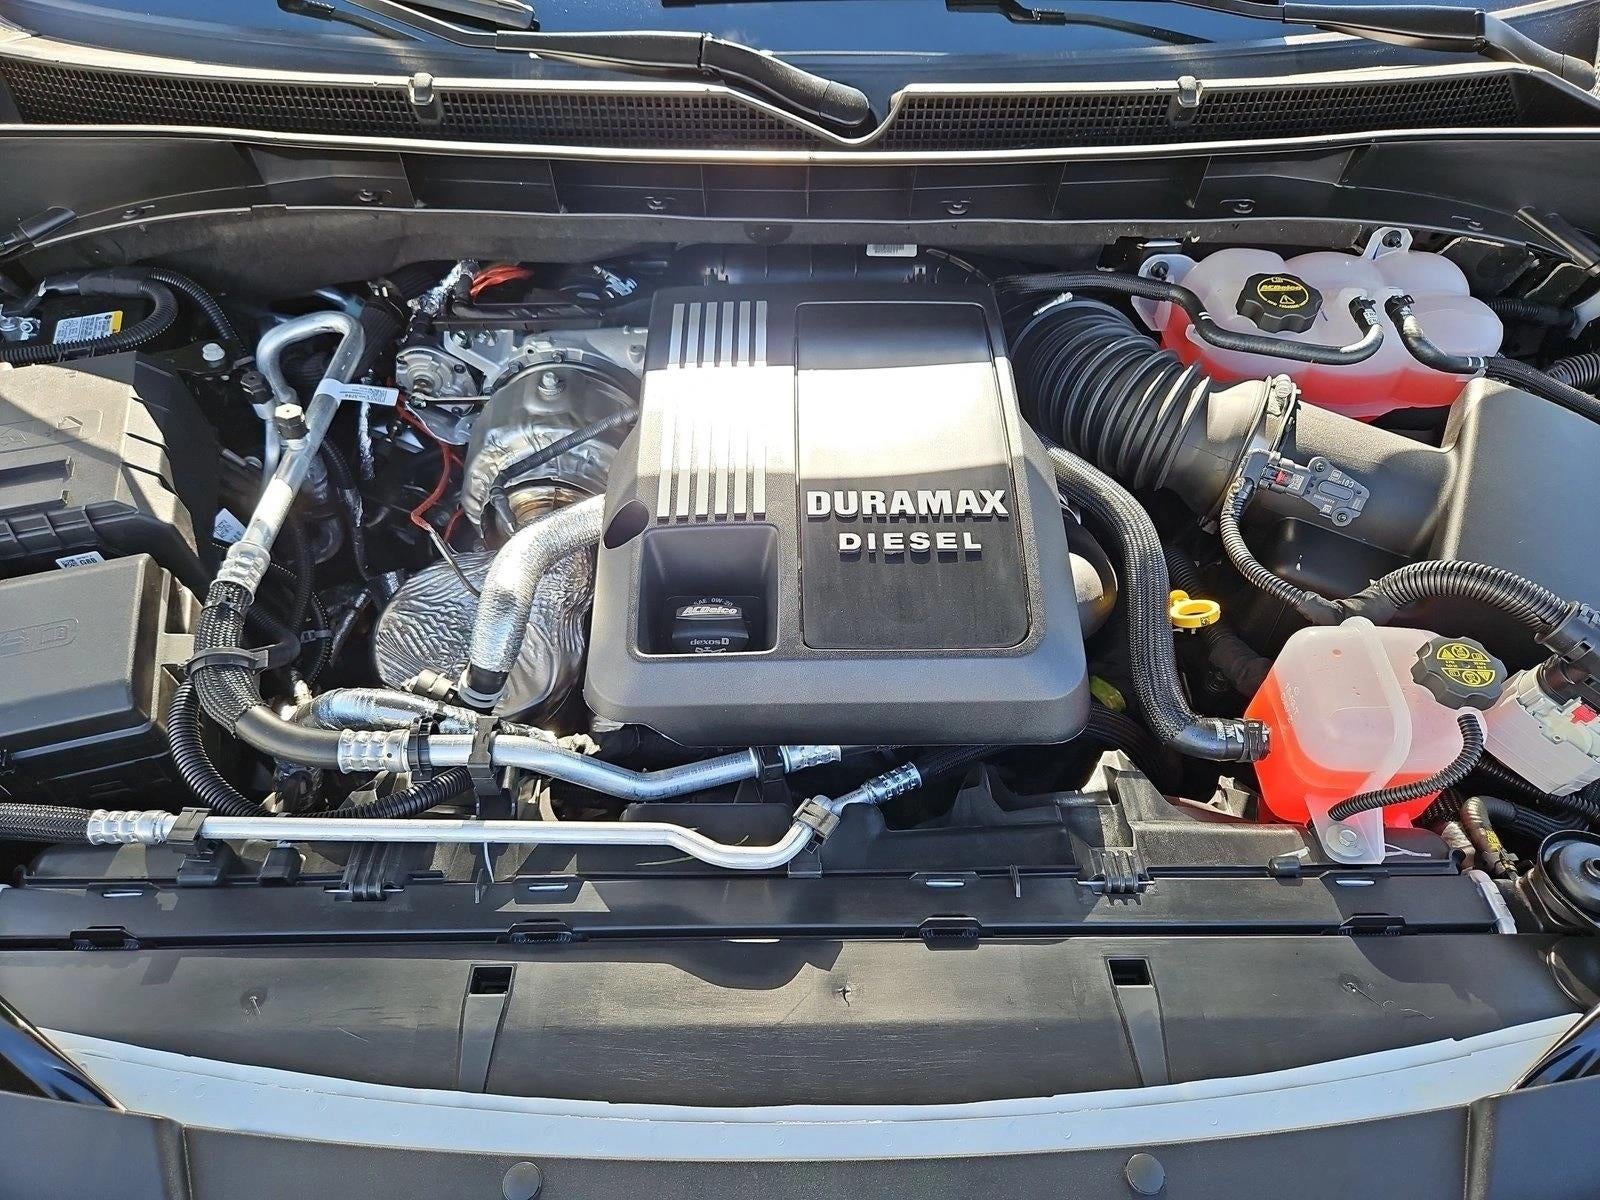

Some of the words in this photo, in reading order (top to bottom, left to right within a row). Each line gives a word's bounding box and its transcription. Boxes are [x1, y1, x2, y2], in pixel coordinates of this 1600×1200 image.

[806, 489, 1010, 518] DURAMAX
[838, 531, 983, 552] DIESEL
[681, 606, 738, 616] ACDelco
